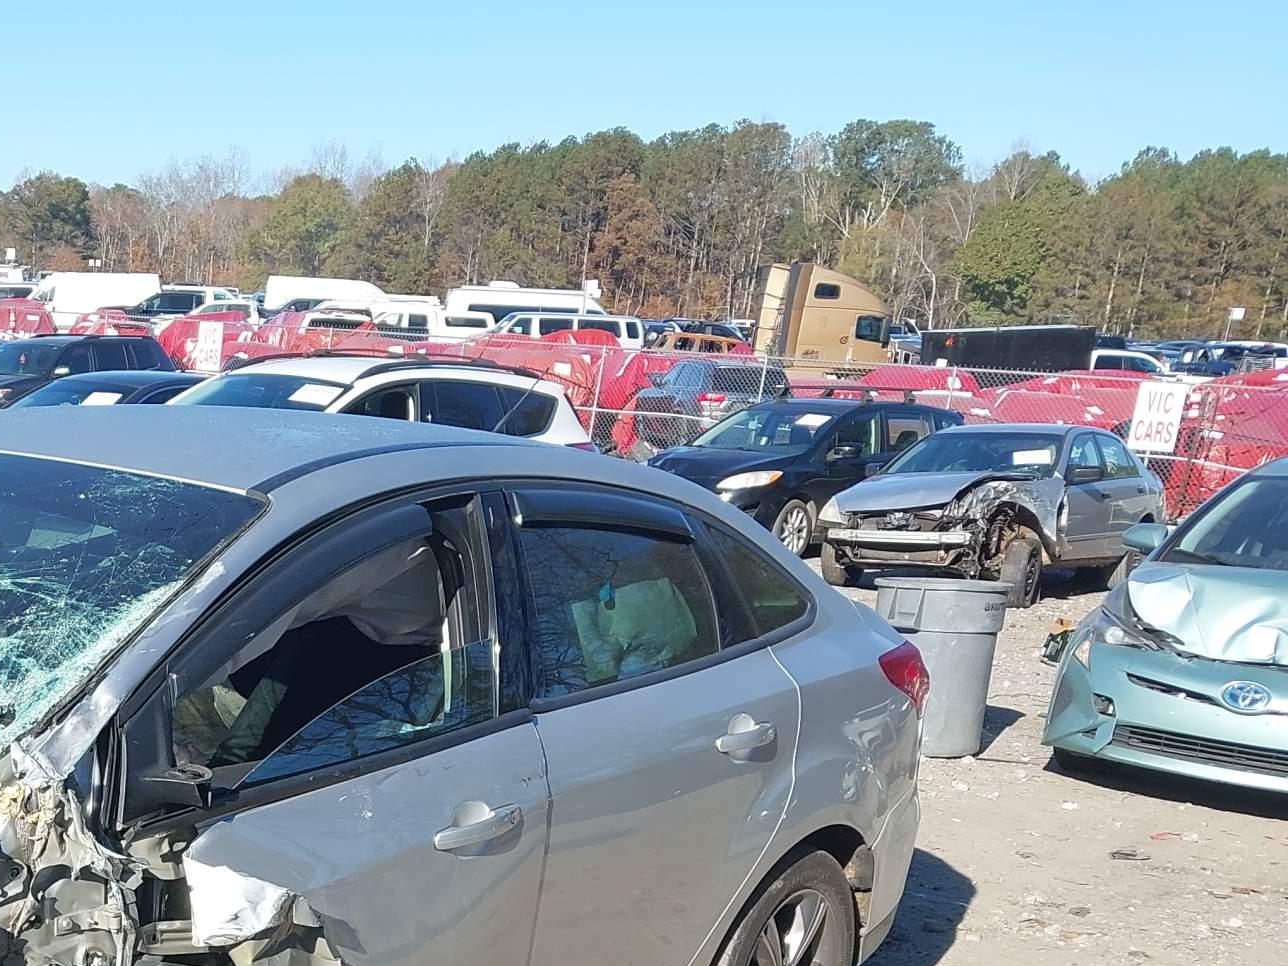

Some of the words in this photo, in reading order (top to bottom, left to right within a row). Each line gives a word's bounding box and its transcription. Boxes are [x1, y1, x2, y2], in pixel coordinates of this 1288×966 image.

[198, 348, 219, 366] CARS
[1148, 390, 1175, 414] VIC
[1134, 419, 1175, 444] CARS
